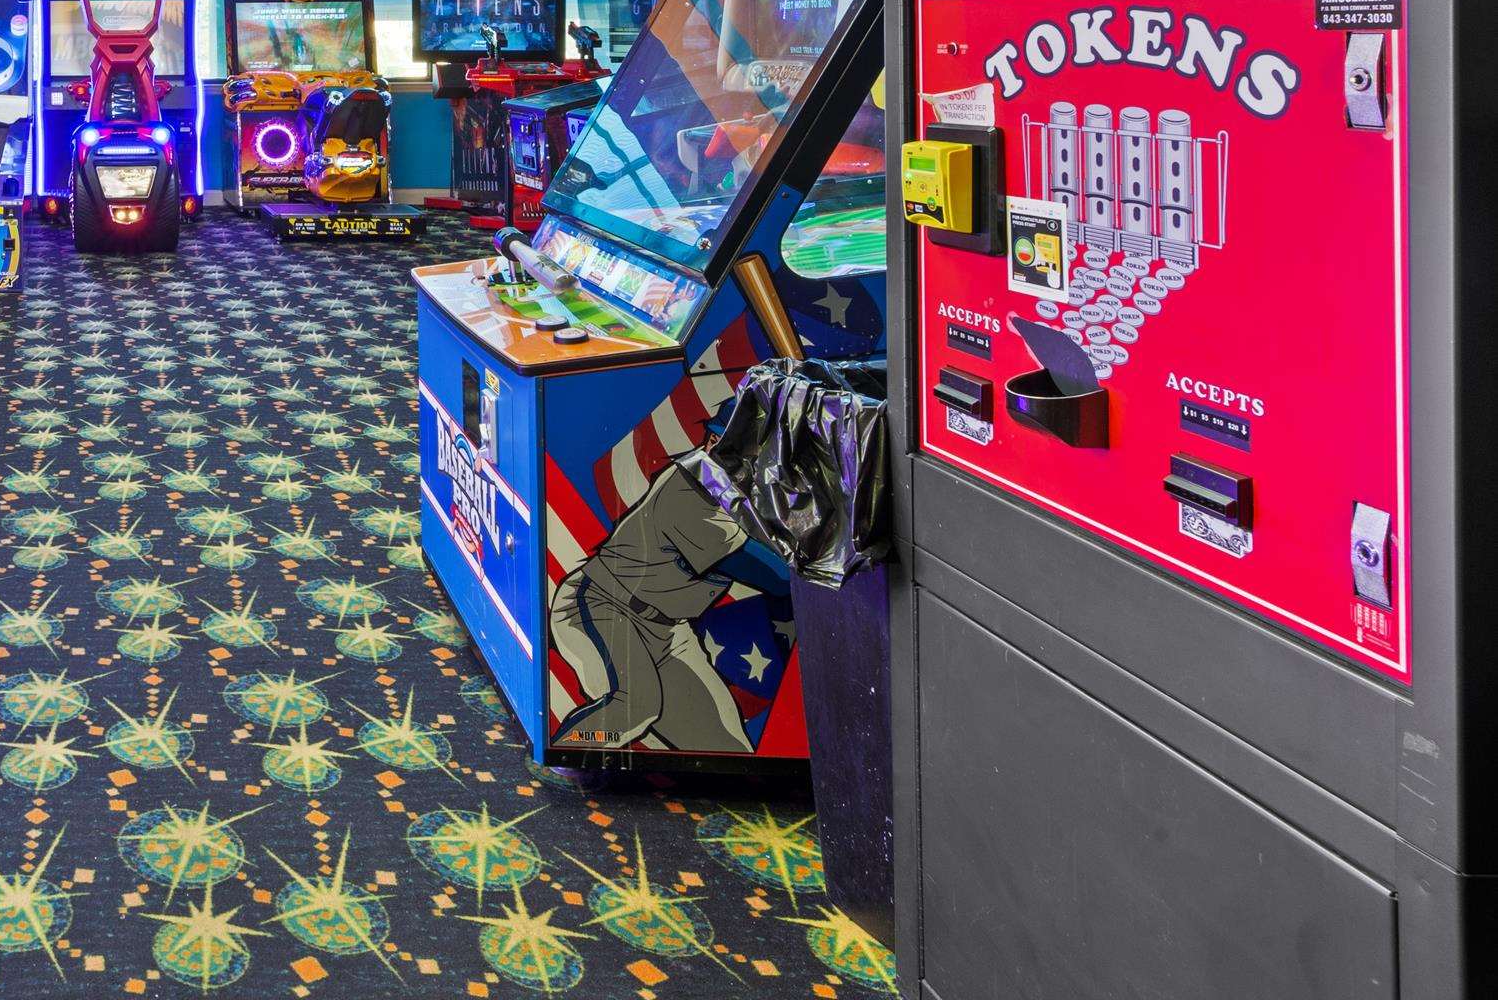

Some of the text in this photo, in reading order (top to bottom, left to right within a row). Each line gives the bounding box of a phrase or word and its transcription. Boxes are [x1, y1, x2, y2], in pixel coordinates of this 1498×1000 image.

[1323, 13, 1393, 23] 843-347-3030
[985, 8, 1301, 119] TOKENS
[944, 112, 986, 120] TRANSACTION
[324, 220, 377, 230] CAUTION
[1126, 262, 1146, 270] TOKEN
[1086, 275, 1105, 283] TOKEN
[1113, 269, 1132, 282] TOKEN
[1110, 283, 1129, 292] TOKEN
[1144, 283, 1164, 292] TOKEN
[1039, 304, 1056, 313] TOKEN
[938, 302, 1001, 333] ACCEPTS
[1115, 326, 1134, 338] TOKEN
[1166, 372, 1265, 417] ACCEPTS
[1201, 413, 1209, 421] $5
[1212, 417, 1224, 426] $10
[1228, 422, 1239, 431] $20
[437, 410, 501, 556] BASEBALL
[453, 480, 483, 541] PRO.
[568, 730, 620, 742] ANDAMIRO
